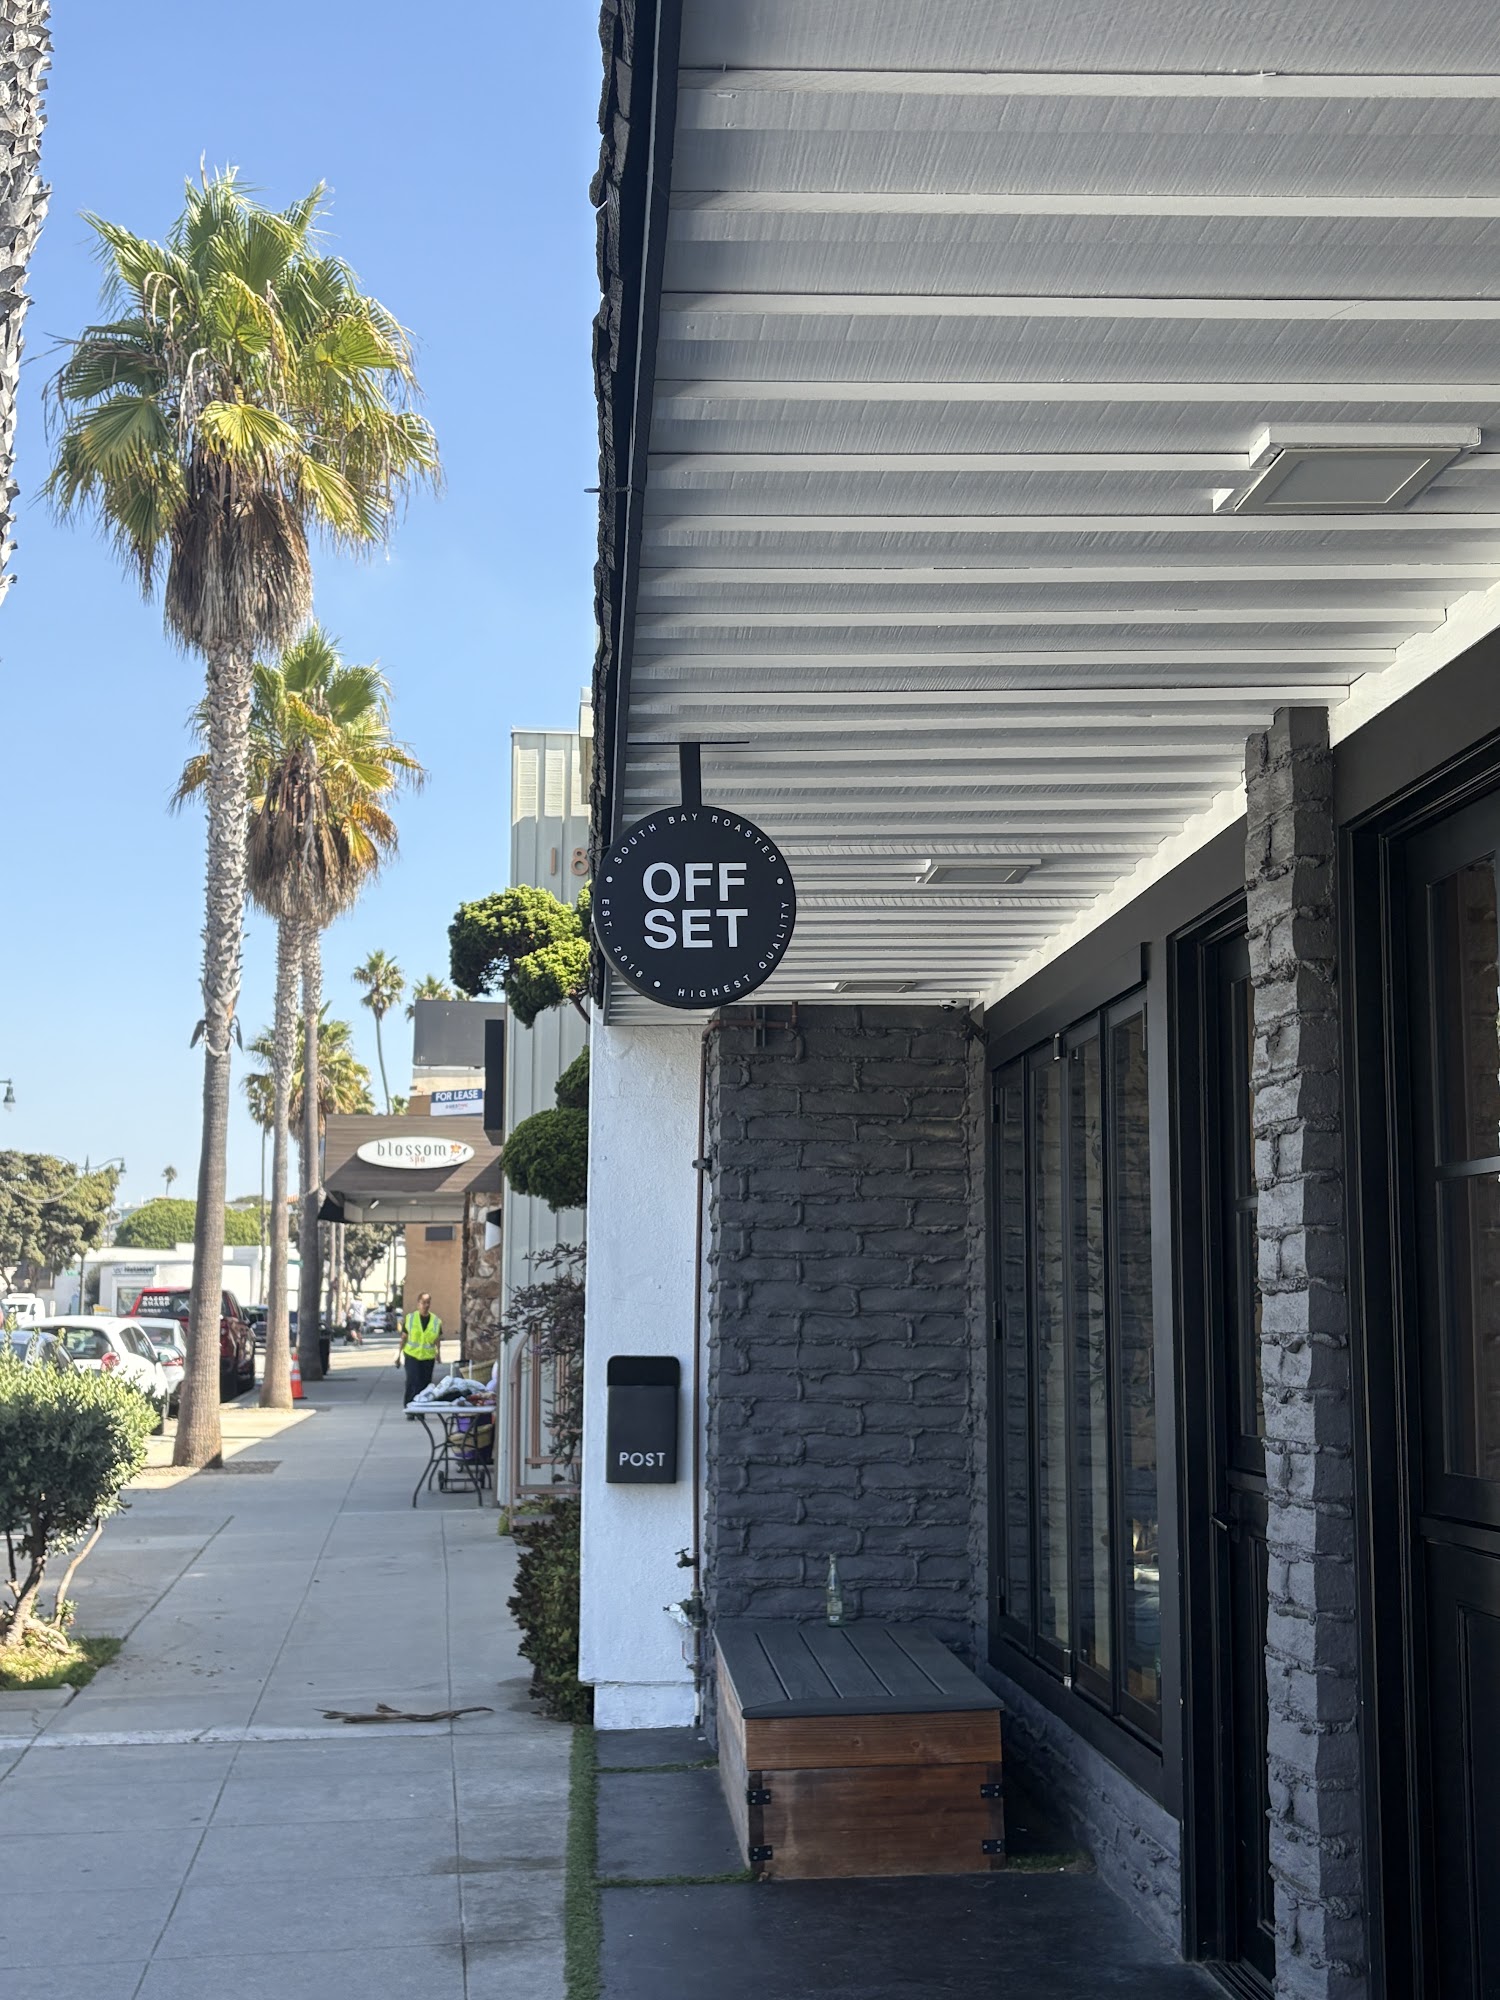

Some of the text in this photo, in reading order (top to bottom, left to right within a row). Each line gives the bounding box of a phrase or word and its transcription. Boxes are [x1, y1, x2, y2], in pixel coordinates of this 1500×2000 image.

[614, 813, 777, 864] SOUTH BAY ROASTED
[642, 861, 747, 903] OFF
[601, 898, 643, 978] EST. 2018
[643, 908, 748, 949] SET
[678, 901, 790, 998] HIGHEST QUALITY
[435, 1089, 479, 1102] FOR LEASE
[377, 1140, 447, 1157] blossom
[409, 1156, 426, 1167] spa
[618, 1452, 666, 1467] POST
